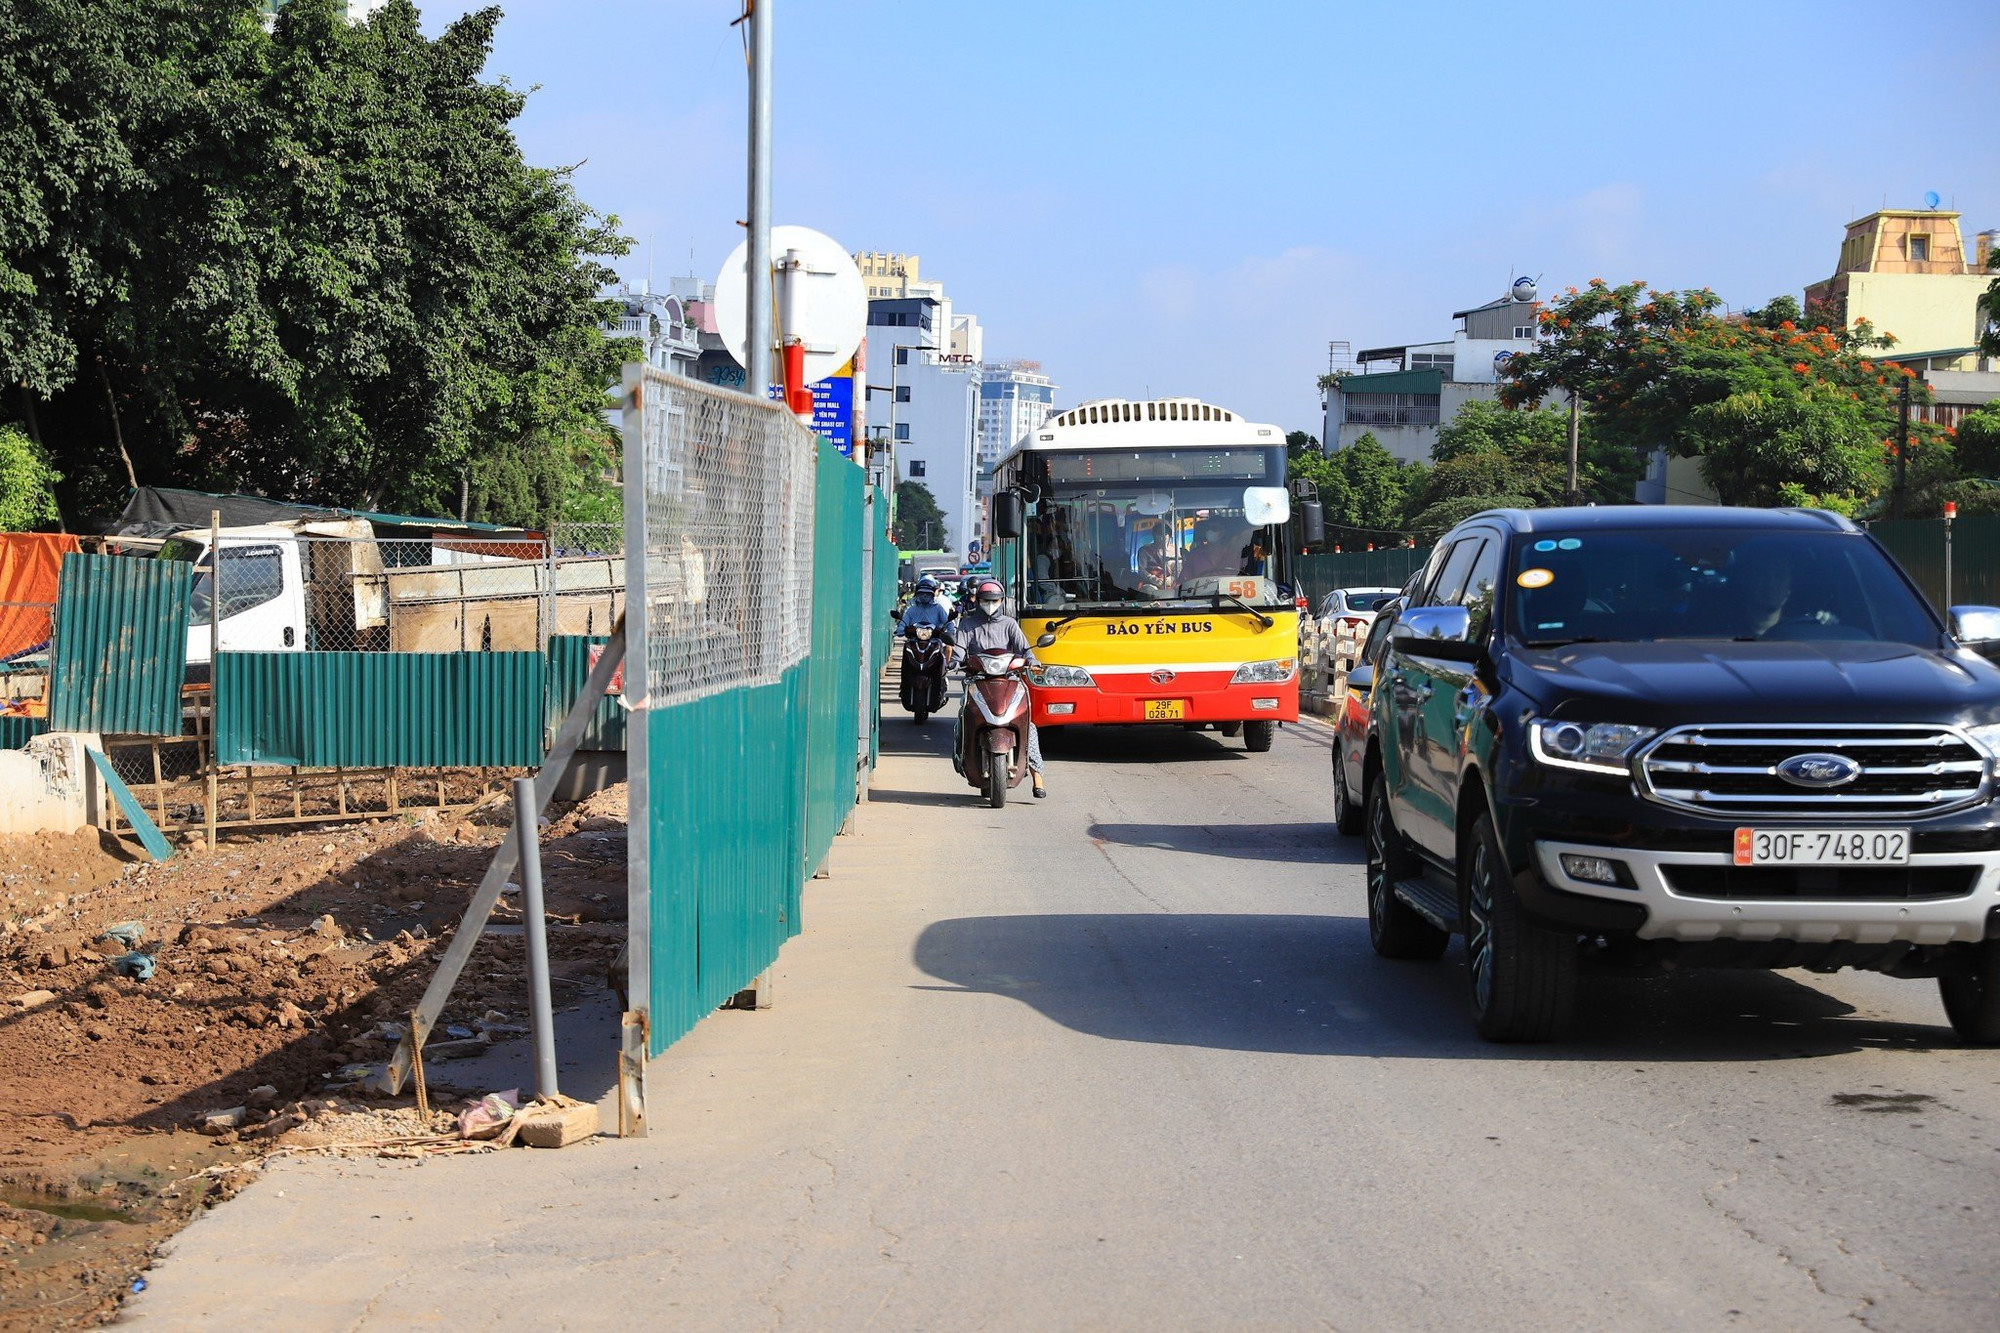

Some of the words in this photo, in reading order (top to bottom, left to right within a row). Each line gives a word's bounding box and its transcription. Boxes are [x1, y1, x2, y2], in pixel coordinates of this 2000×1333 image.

[1228, 580, 1257, 599] 58
[1106, 620, 1140, 635] BẢO
[1144, 618, 1176, 635] YẾN
[1181, 622, 1212, 633] BUS
[1155, 701, 1173, 710] 29F
[1148, 710, 1179, 719] 028.71
[1799, 760, 1840, 779] Ford
[1736, 849, 1750, 857] VIE
[1756, 834, 1904, 860] 30F-748.02
